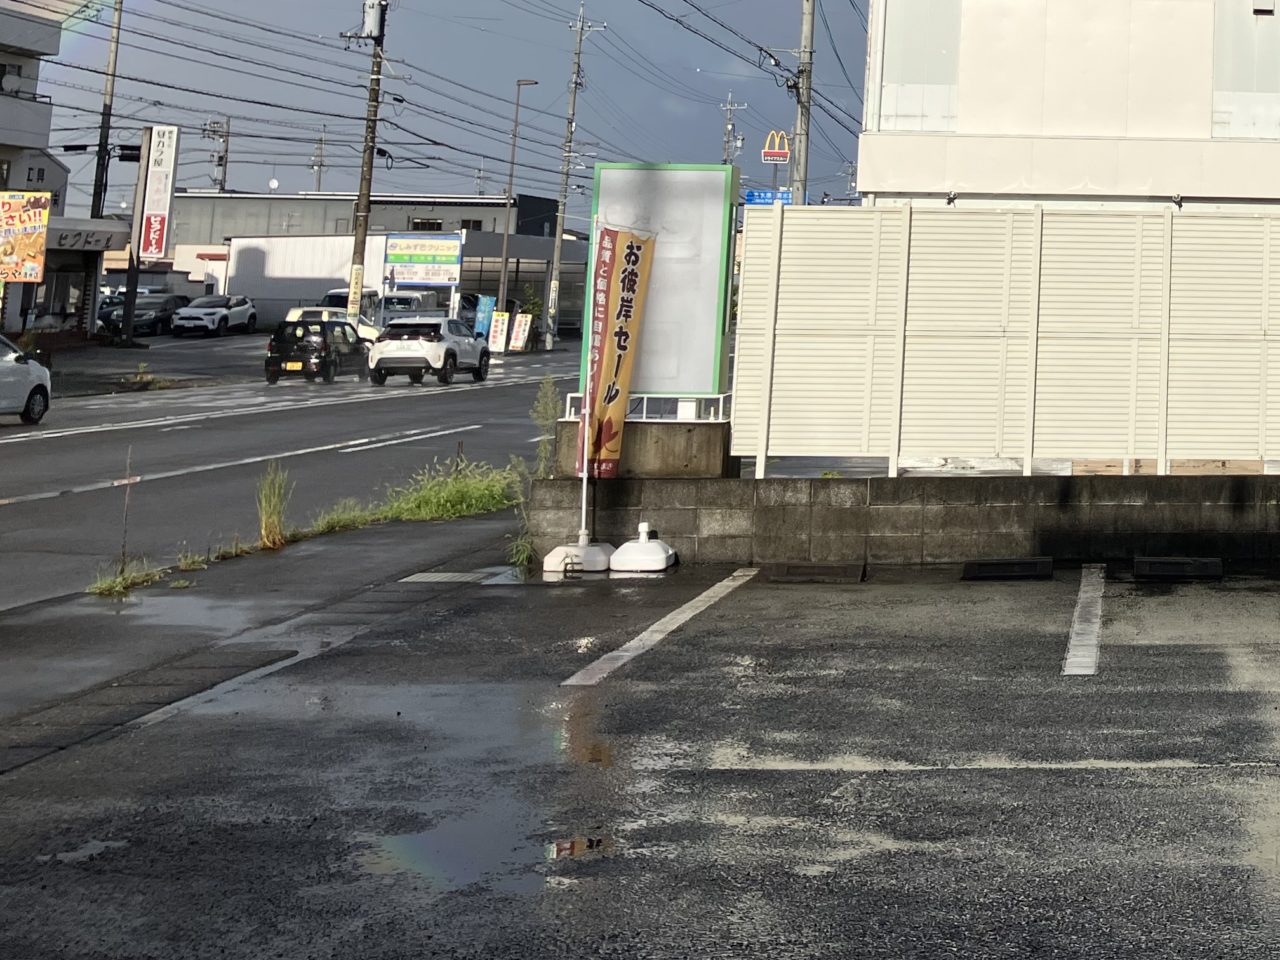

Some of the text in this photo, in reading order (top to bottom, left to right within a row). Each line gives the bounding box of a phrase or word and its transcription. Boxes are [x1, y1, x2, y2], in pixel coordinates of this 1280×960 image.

[603, 240, 642, 405] お彼岸セール
